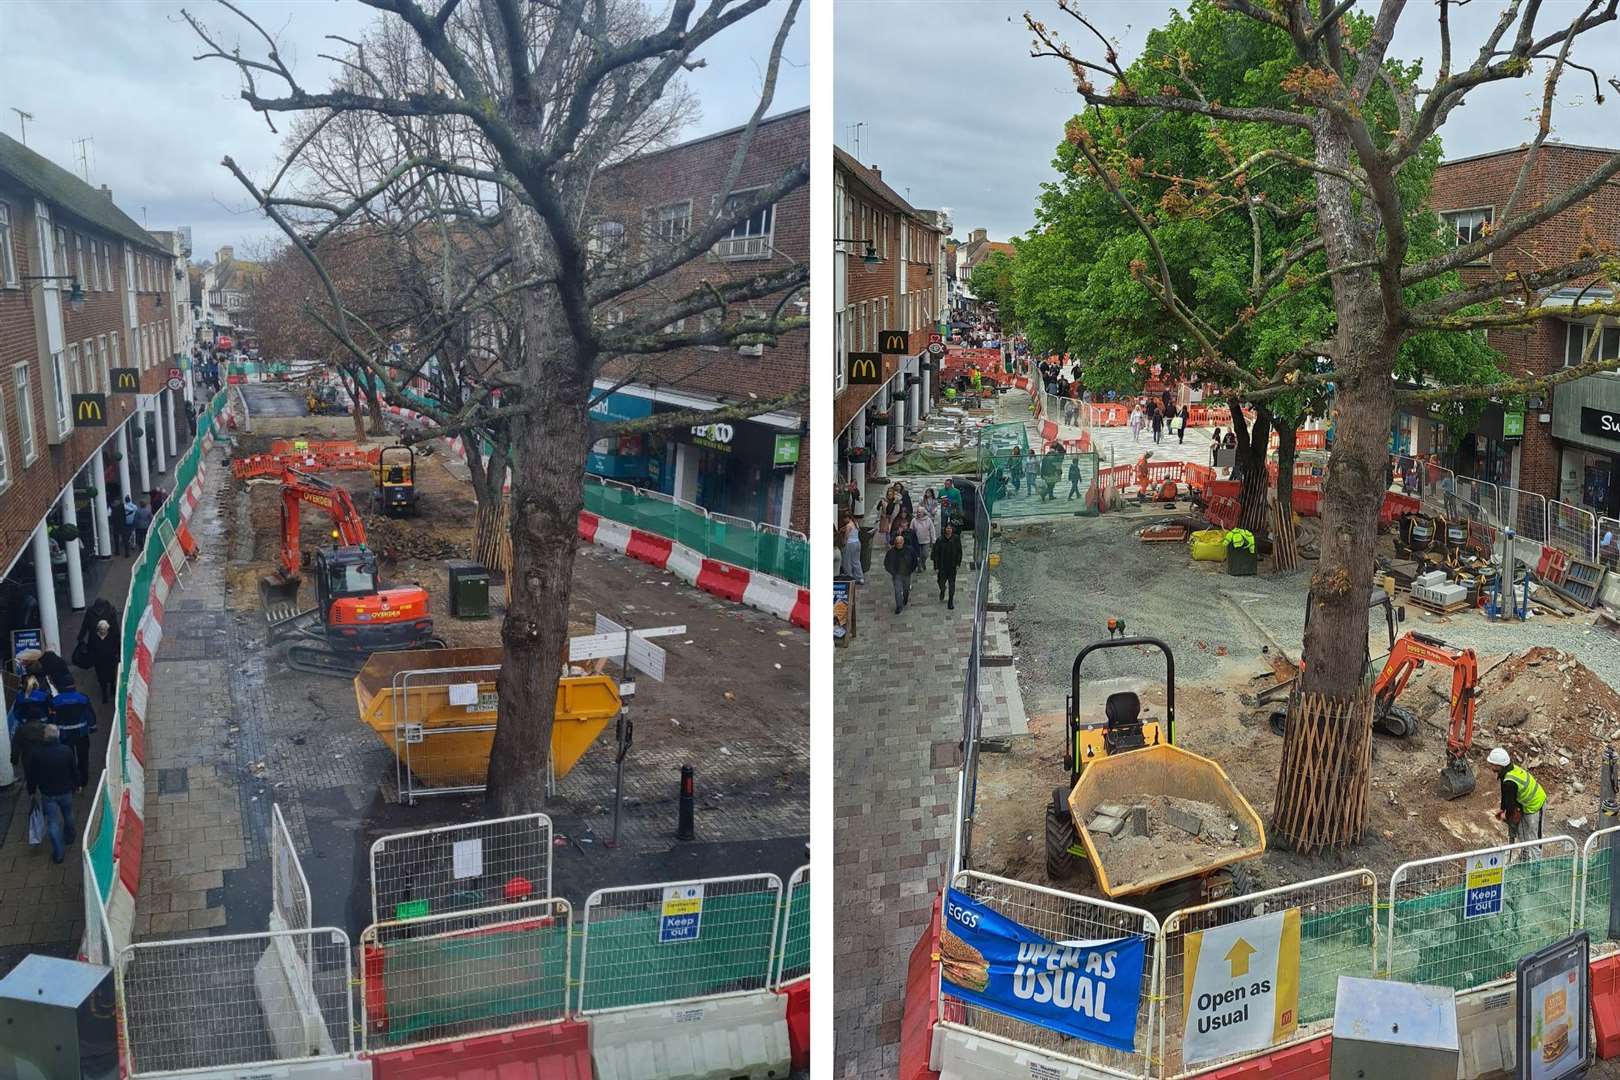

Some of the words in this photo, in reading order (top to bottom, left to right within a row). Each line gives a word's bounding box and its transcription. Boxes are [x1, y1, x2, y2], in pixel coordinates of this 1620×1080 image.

[1471, 889, 1498, 901] Keep
[1475, 900, 1492, 911] out
[667, 917, 695, 929] Keep
[948, 902, 979, 929] EGGS
[671, 927, 688, 937] out
[1017, 941, 1081, 971] OPEN
[1085, 950, 1118, 979] AS
[1012, 963, 1112, 1023] USUAL
[1197, 986, 1246, 1012] Open
[1249, 979, 1271, 996] as
[1197, 1003, 1248, 1034] Usual
